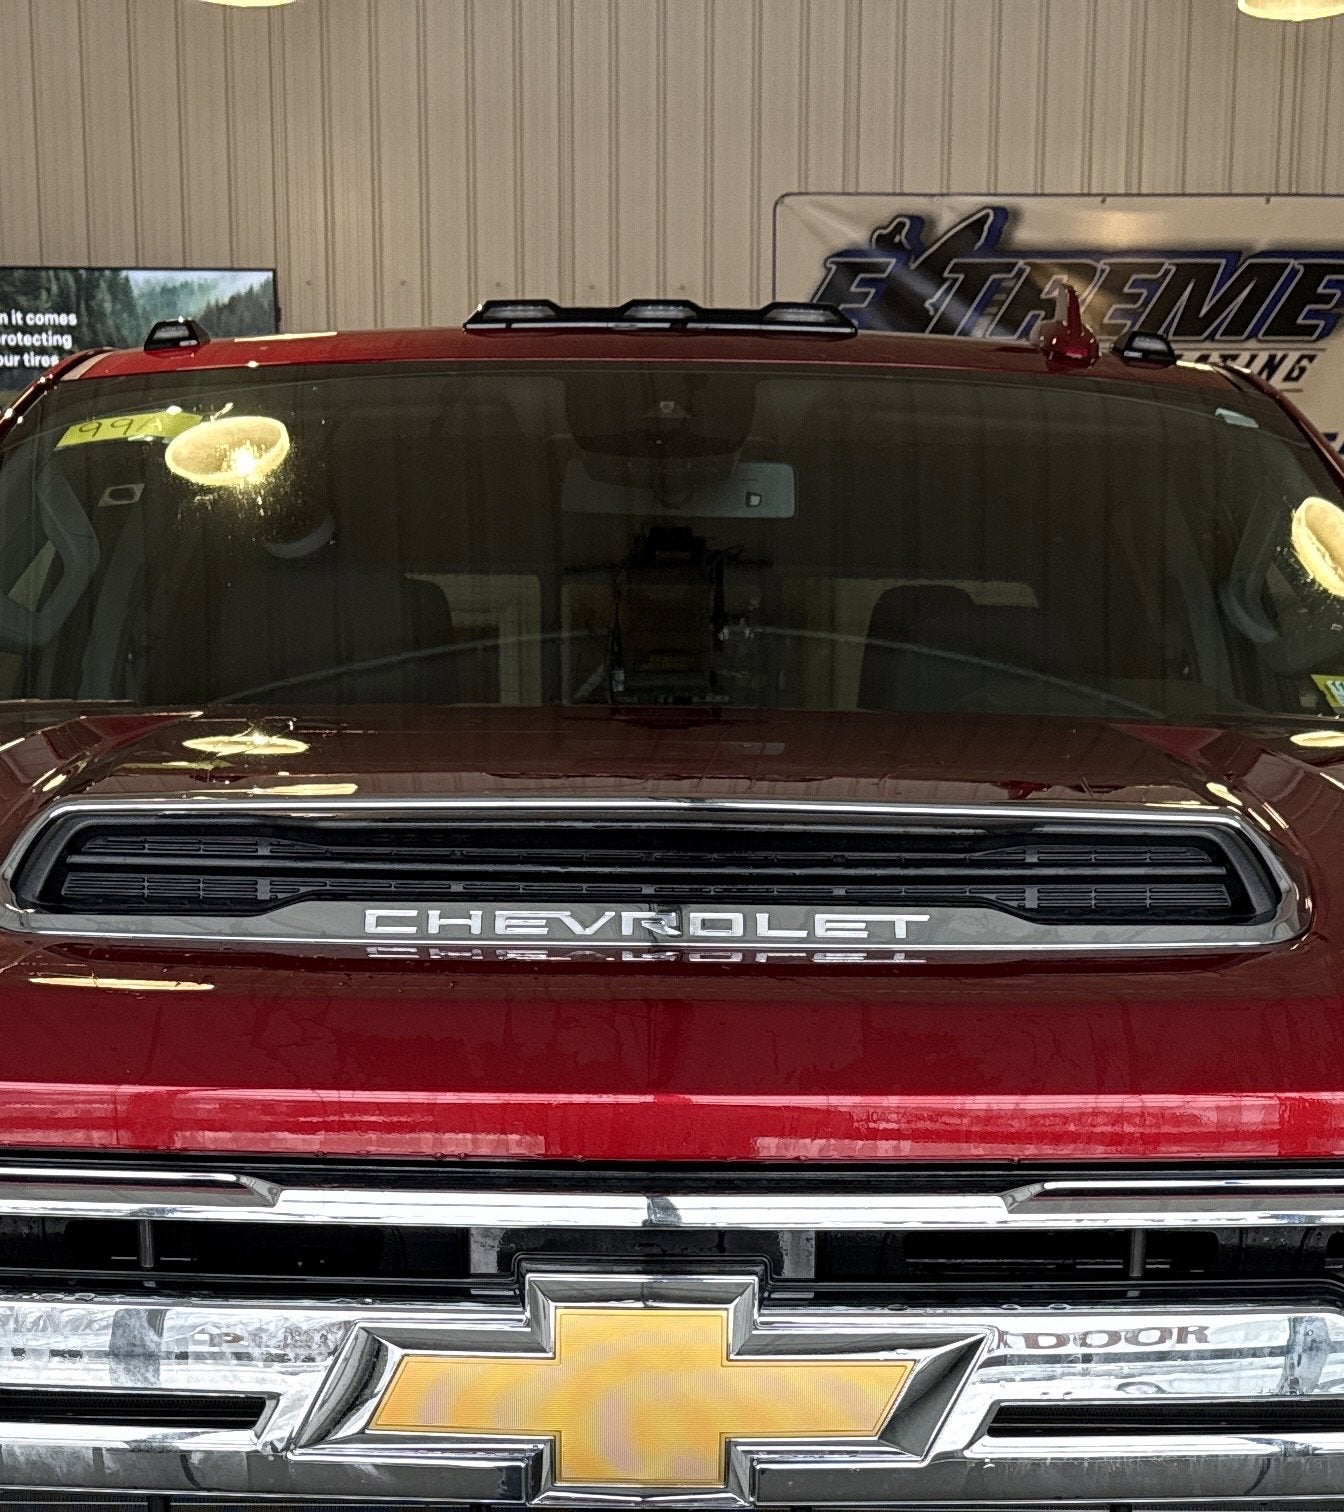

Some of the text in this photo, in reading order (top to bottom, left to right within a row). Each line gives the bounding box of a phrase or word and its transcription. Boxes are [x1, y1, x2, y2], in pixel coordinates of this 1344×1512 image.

[11, 309, 23, 325] it
[26, 312, 78, 327] comes
[23, 351, 59, 368] tires
[364, 908, 931, 940] CHEVROLET
